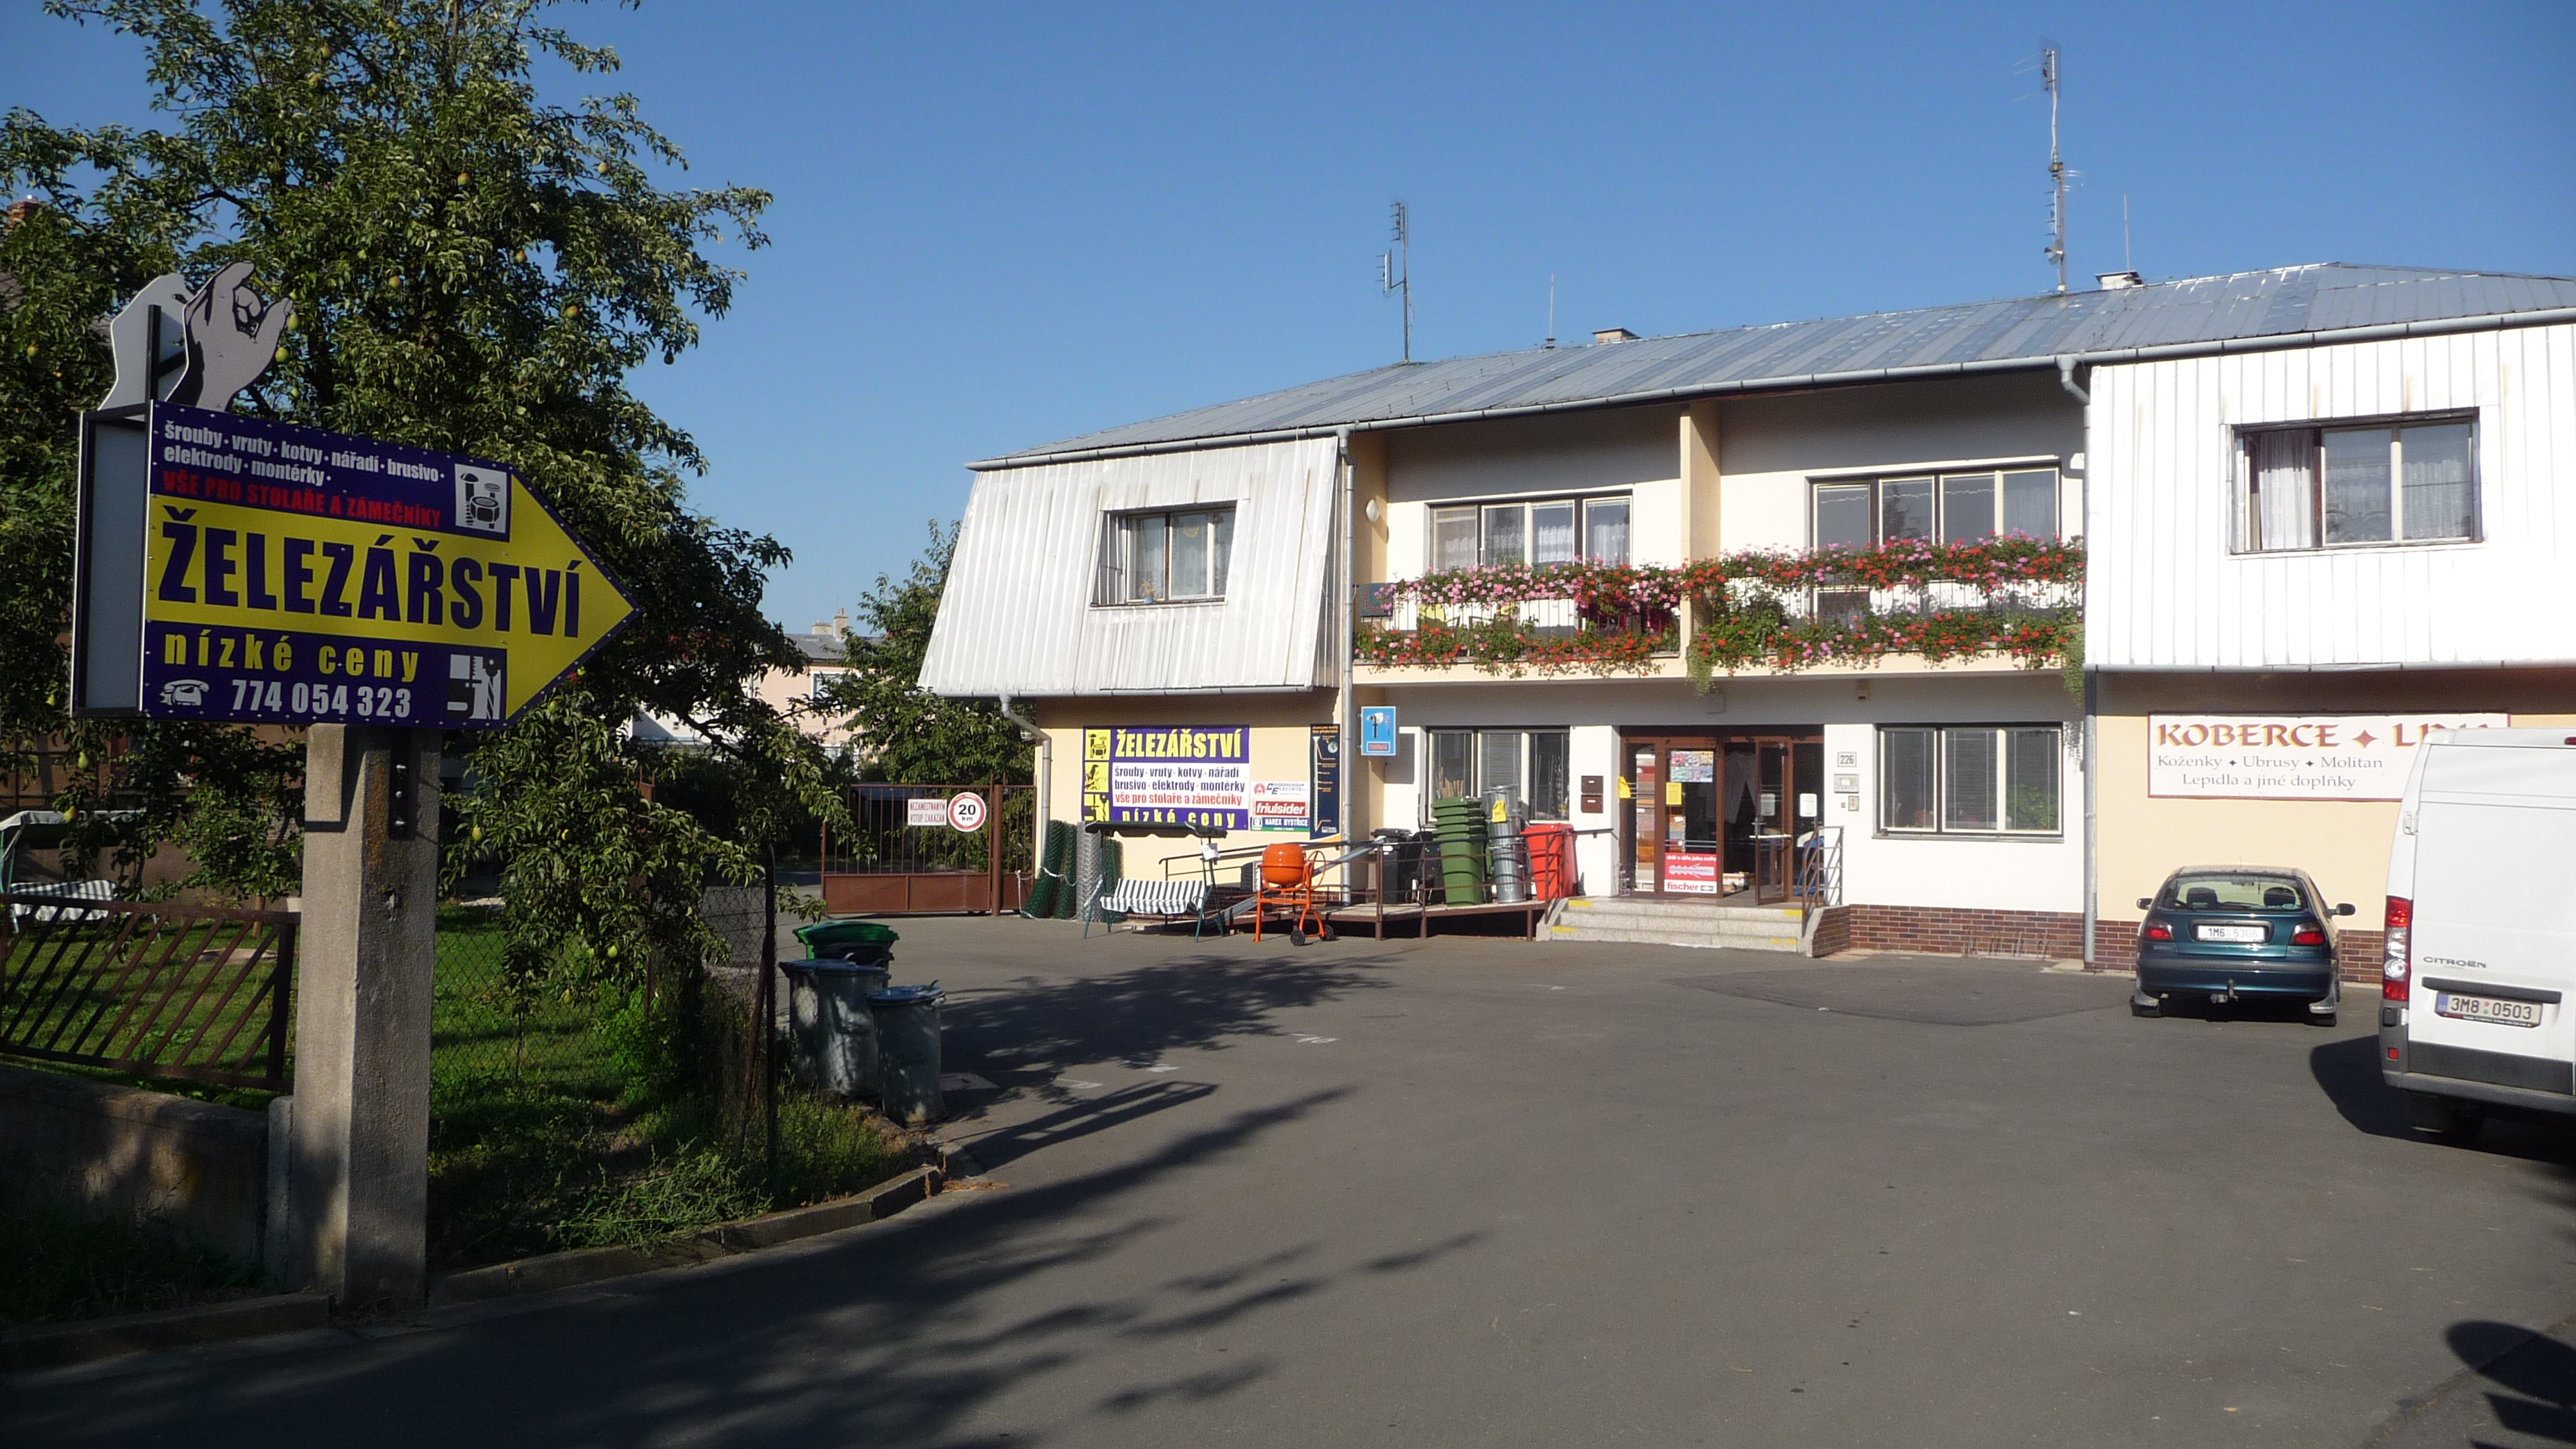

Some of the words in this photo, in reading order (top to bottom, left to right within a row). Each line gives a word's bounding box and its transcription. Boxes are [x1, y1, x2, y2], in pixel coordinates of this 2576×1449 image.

[164, 420, 223, 448] šrouby
[232, 434, 272, 457] vruty
[281, 441, 323, 464] kotvy
[331, 451, 379, 473] nářadí
[387, 459, 439, 482] brusivo
[164, 446, 243, 475] elektrody
[251, 460, 325, 486] montérky
[162, 469, 198, 494] VŠE
[205, 477, 241, 501] PRO
[247, 484, 324, 513] STOLAŘE
[330, 495, 341, 515] A
[348, 495, 441, 527] ZÁMEČNÍKY
[158, 505, 583, 638] ŽELEZÁŘSTVÍ
[164, 629, 293, 672] nízké
[319, 645, 419, 683] ceny
[232, 679, 280, 712] 774
[291, 684, 349, 715] 054
[357, 687, 412, 718] 323
[1115, 729, 1242, 758] ŽELEZÁŘSTVÍ
[2158, 723, 2340, 748] KOBERCE
[1840, 755, 1854, 764] 226
[2158, 755, 2222, 770] Koženky
[2243, 756, 2300, 770] Ubrusy
[2321, 756, 2383, 769] Molitan
[1115, 766, 1144, 778] šrouby
[1150, 768, 1172, 778] vruty
[1178, 767, 1203, 779] kotvy
[1208, 766, 1239, 778] nářadí
[1115, 779, 1146, 790] brusivo
[1152, 780, 1195, 791] elektrody
[1201, 781, 1245, 793] montérky
[2183, 774, 2240, 786] Lepidla
[2244, 778, 2252, 786] a
[2256, 773, 2285, 788] jiné
[2290, 774, 2357, 790] doplňky
[1115, 792, 1130, 803] vše
[1133, 795, 1146, 804] pro
[1149, 793, 1182, 804] stolaře
[1192, 793, 1242, 806] zámečníky
[958, 804, 976, 815] 20
[1256, 803, 1305, 815] friulsider
[1122, 808, 1176, 823] nízké
[1188, 812, 1235, 828] ceny
[1667, 882, 1699, 890] fischer
[2208, 928, 2226, 937] 1M6
[2423, 956, 2487, 969] CITROËN
[2450, 998, 2480, 1013] 3M8
[2492, 1003, 2532, 1020] 0503
